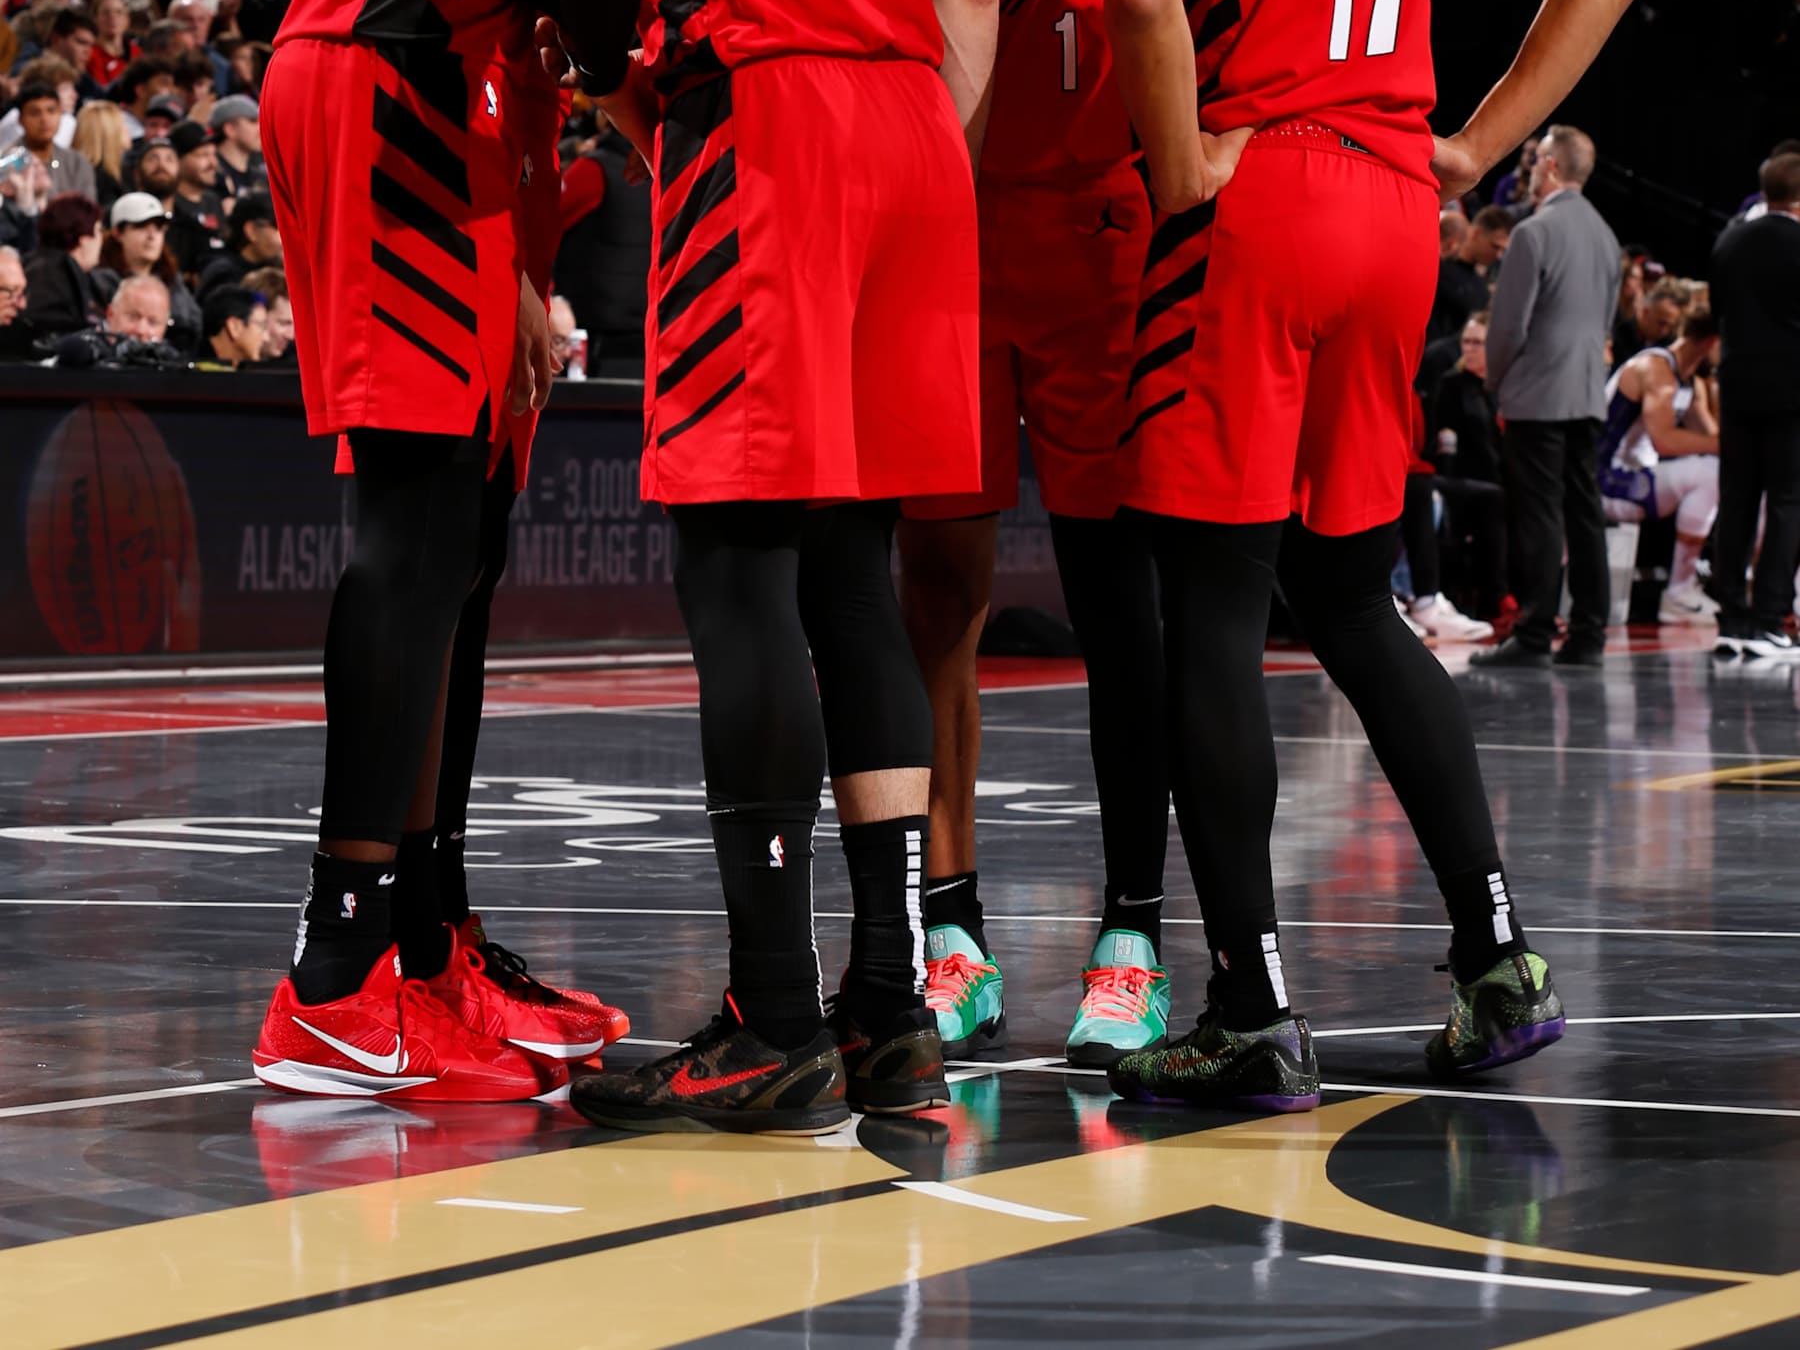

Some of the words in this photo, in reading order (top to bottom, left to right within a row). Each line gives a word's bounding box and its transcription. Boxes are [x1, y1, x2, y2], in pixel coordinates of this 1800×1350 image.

[1054, 11, 1077, 91] 1
[515, 523, 639, 586] MILEAGE
[645, 523, 675, 586] PL
